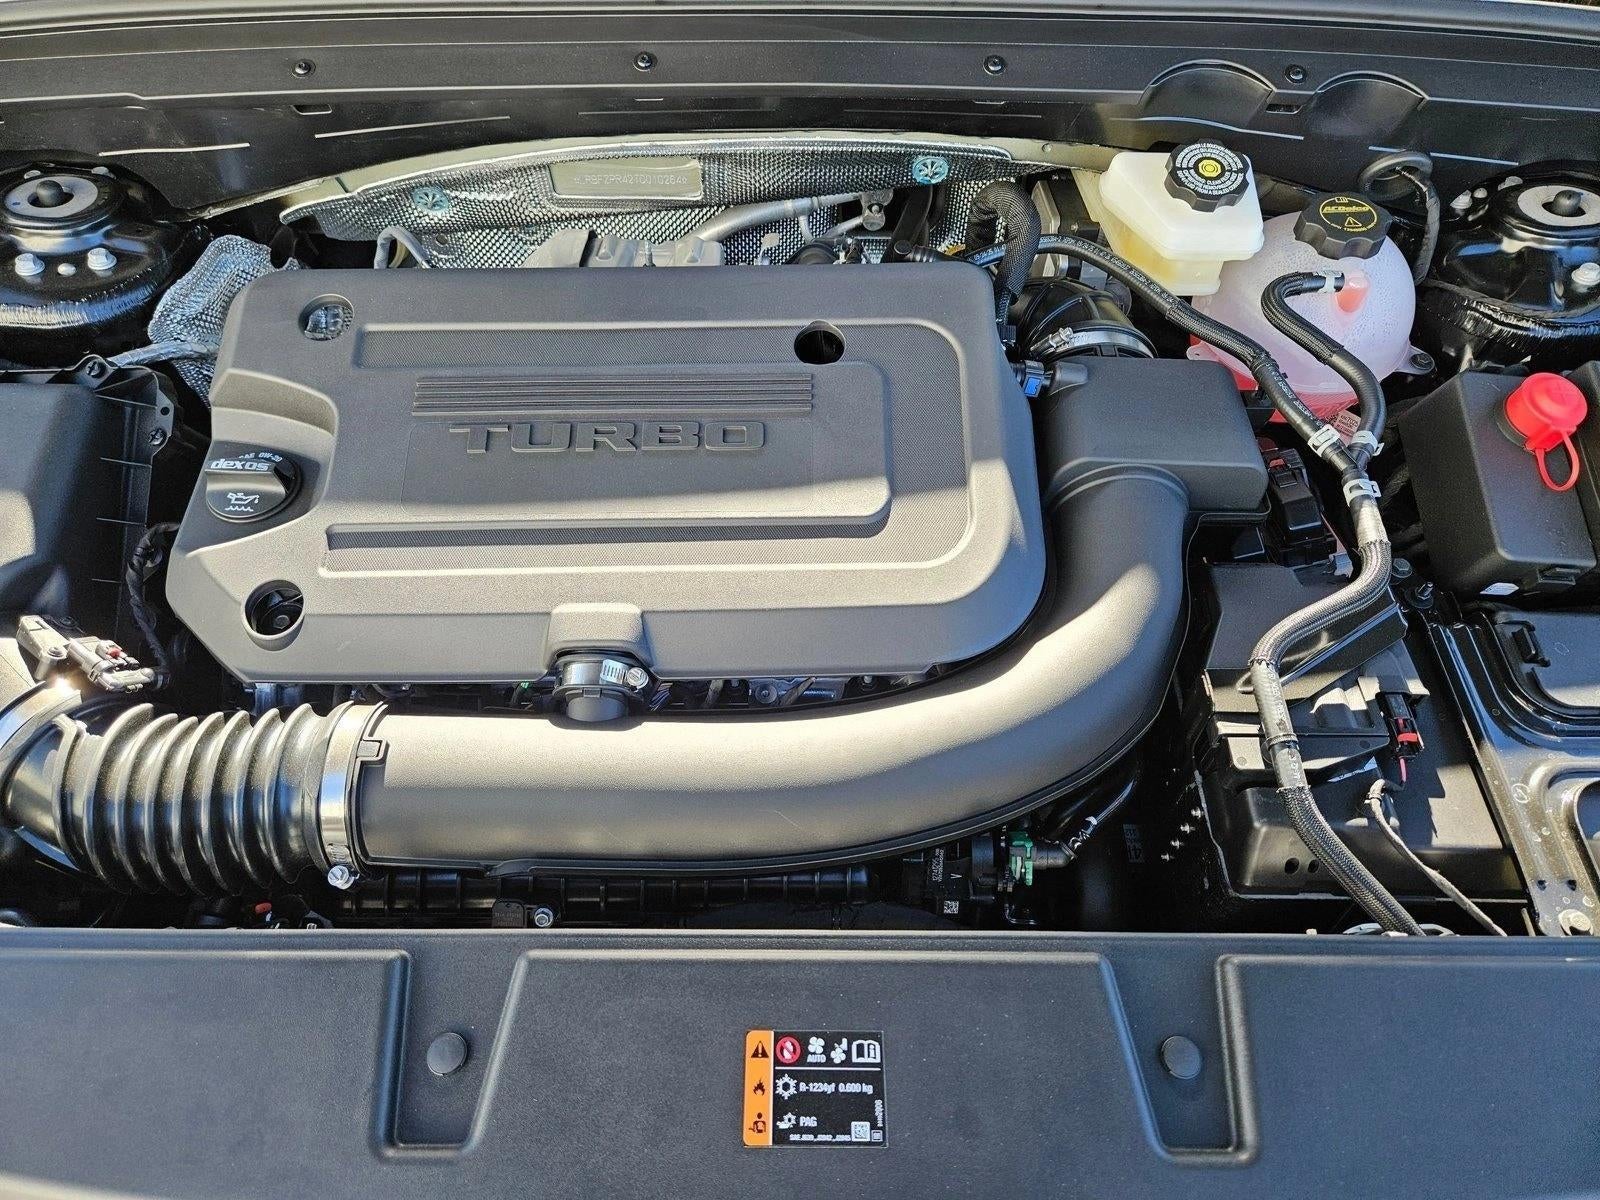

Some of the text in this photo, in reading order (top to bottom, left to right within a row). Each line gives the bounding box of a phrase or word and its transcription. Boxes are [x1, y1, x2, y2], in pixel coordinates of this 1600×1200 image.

[449, 421, 765, 453] TURBO
[211, 458, 270, 471] dexos
[807, 1054, 826, 1063] AUTO
[799, 1082, 874, 1095] R-1234yf 0.600 kg
[800, 1116, 818, 1128] PAG
